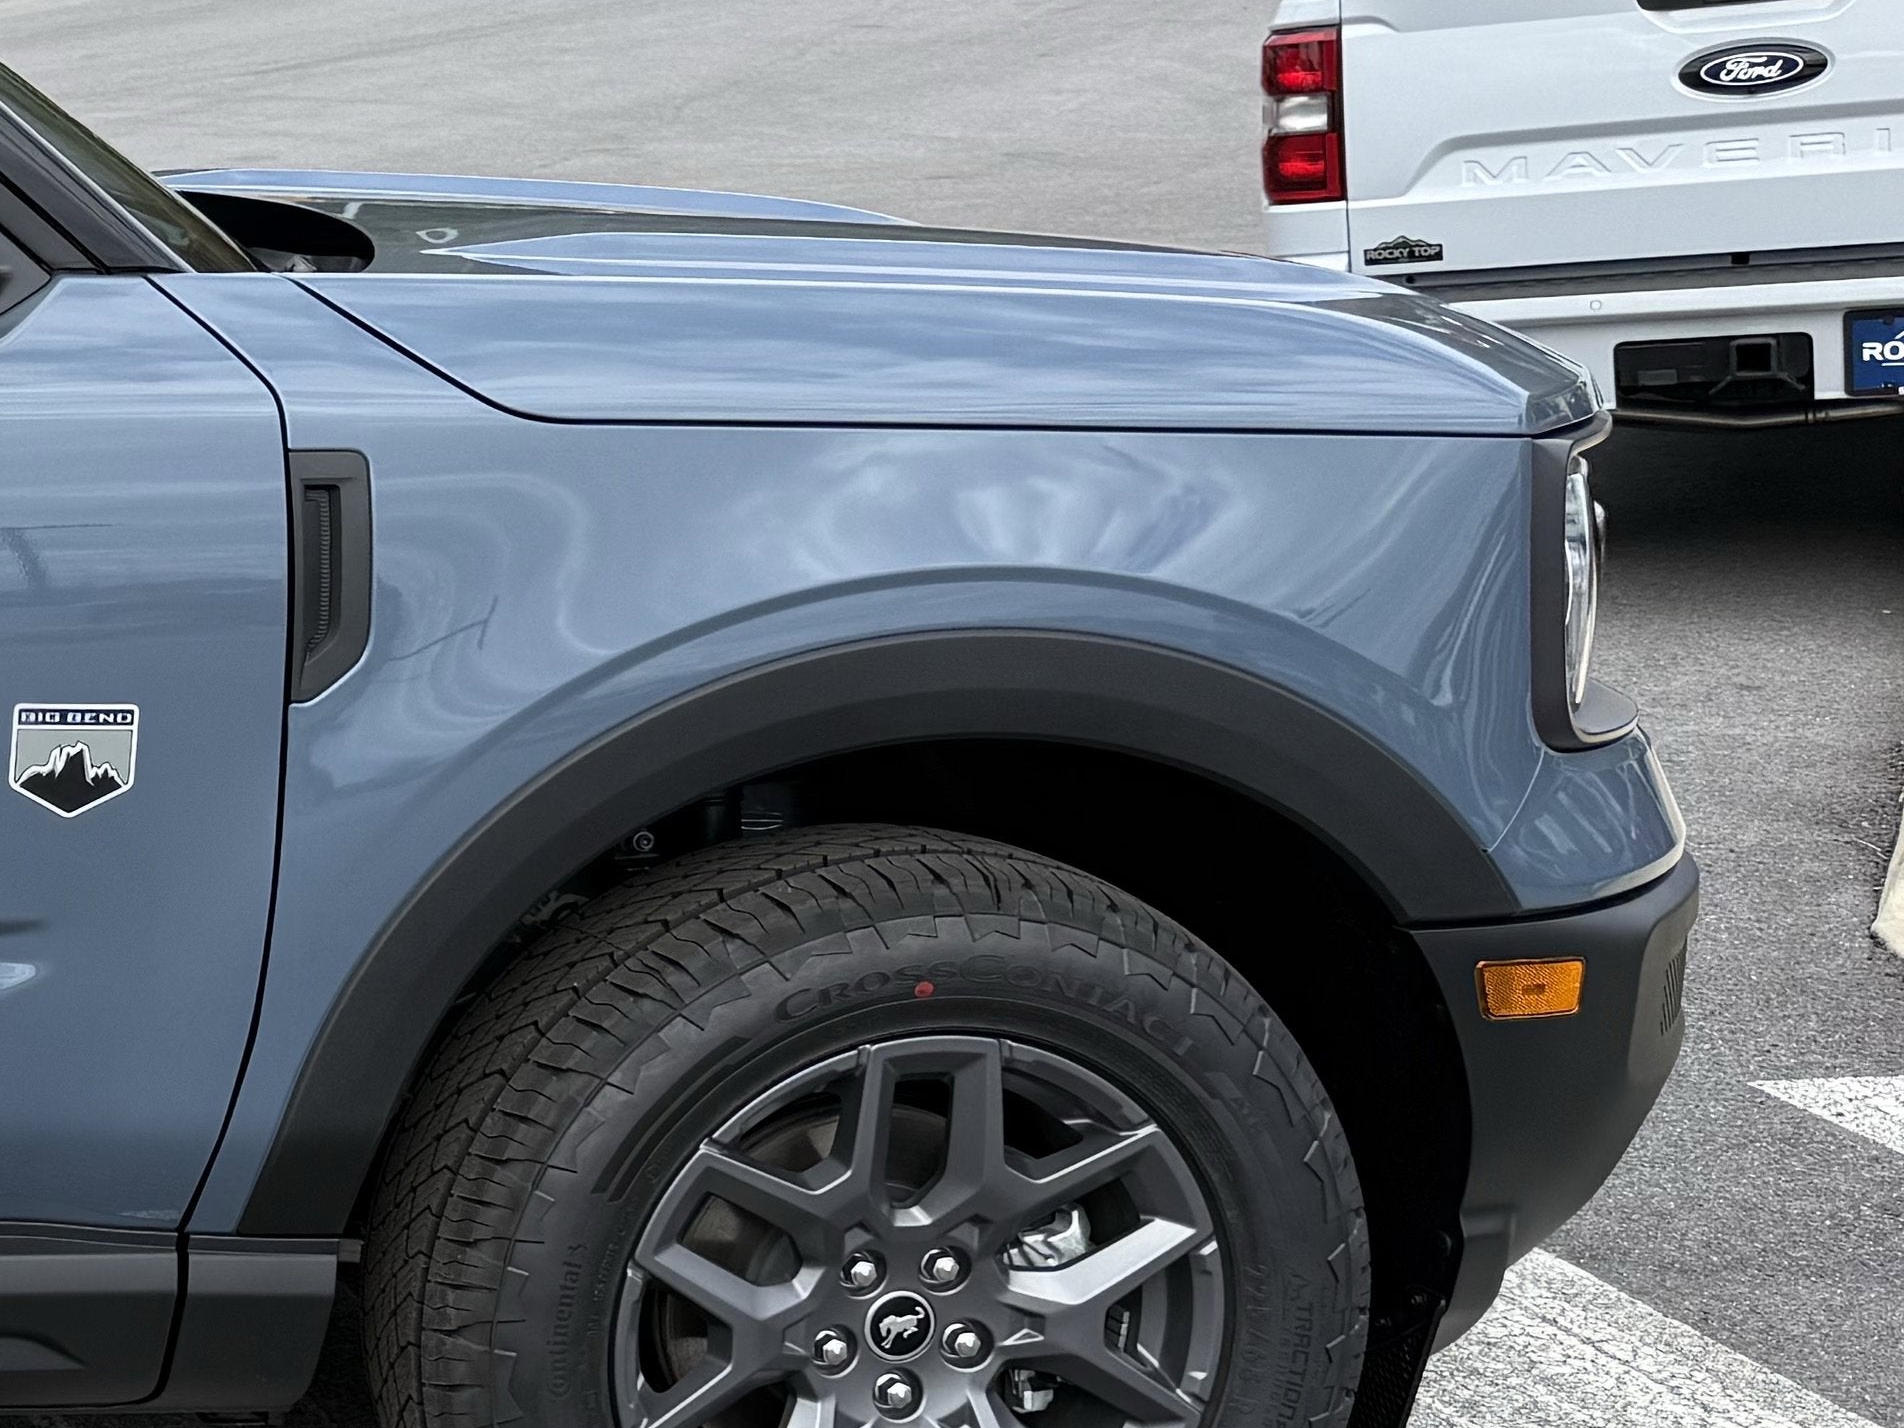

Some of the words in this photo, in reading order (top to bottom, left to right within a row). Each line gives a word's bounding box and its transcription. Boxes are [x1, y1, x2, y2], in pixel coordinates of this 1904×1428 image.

[1719, 56, 1784, 82] Ford
[1366, 247, 1410, 260] ROCKY
[1413, 245, 1441, 257] TOP
[20, 711, 60, 723] BIG
[66, 711, 132, 723] BEND
[546, 1258, 584, 1401] Continental
